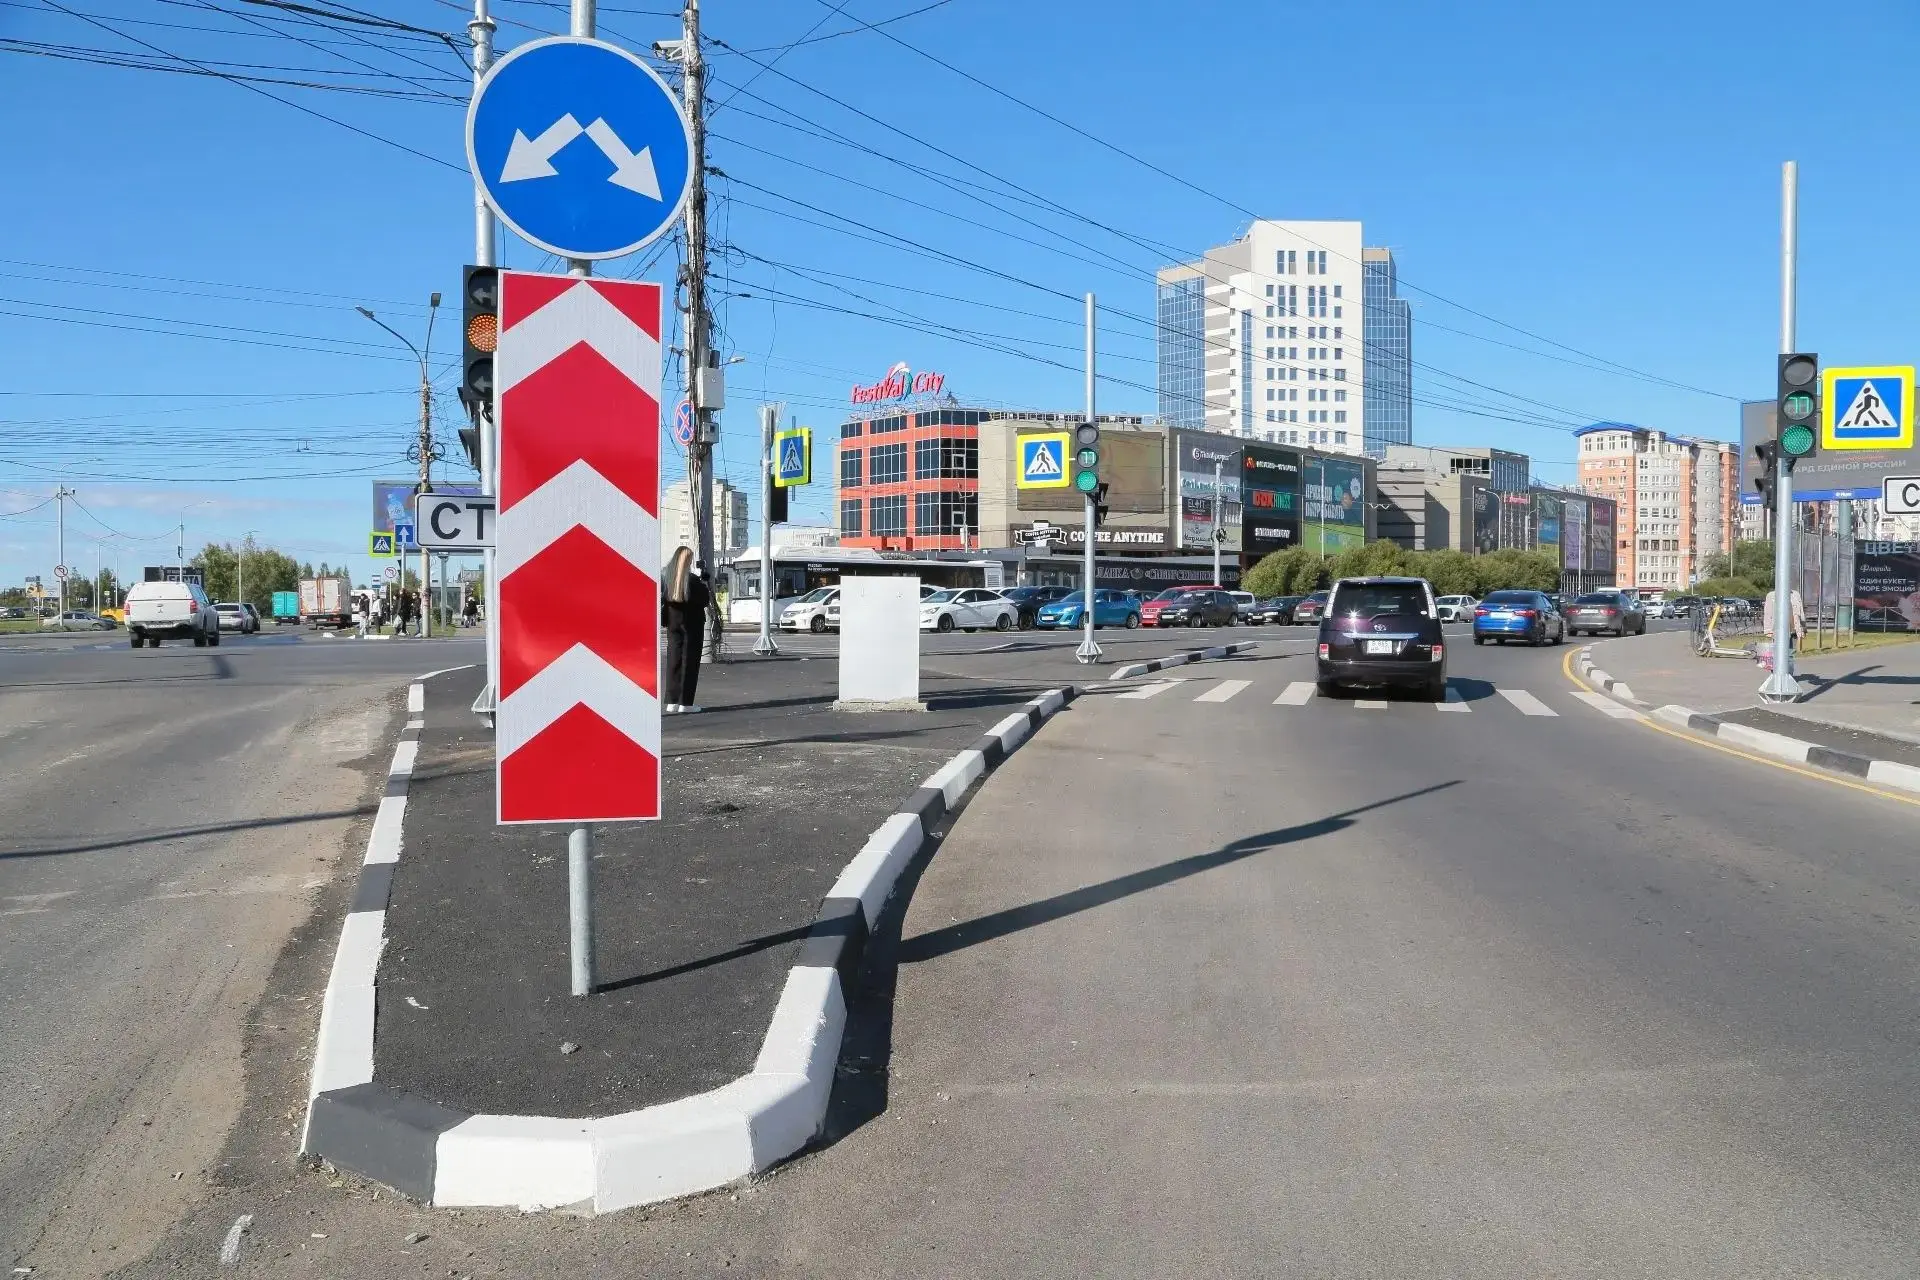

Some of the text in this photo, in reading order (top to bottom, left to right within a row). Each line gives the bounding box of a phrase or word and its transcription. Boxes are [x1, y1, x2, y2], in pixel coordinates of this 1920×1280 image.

[912, 371, 946, 394] City
[1818, 462, 1860, 472] ЕДИНОЙ
[1863, 460, 1907, 469] РОССИИ
[1070, 531, 1164, 543] COEE ANYTIME
[1881, 584, 1916, 592] ЭМОЦИЙ
